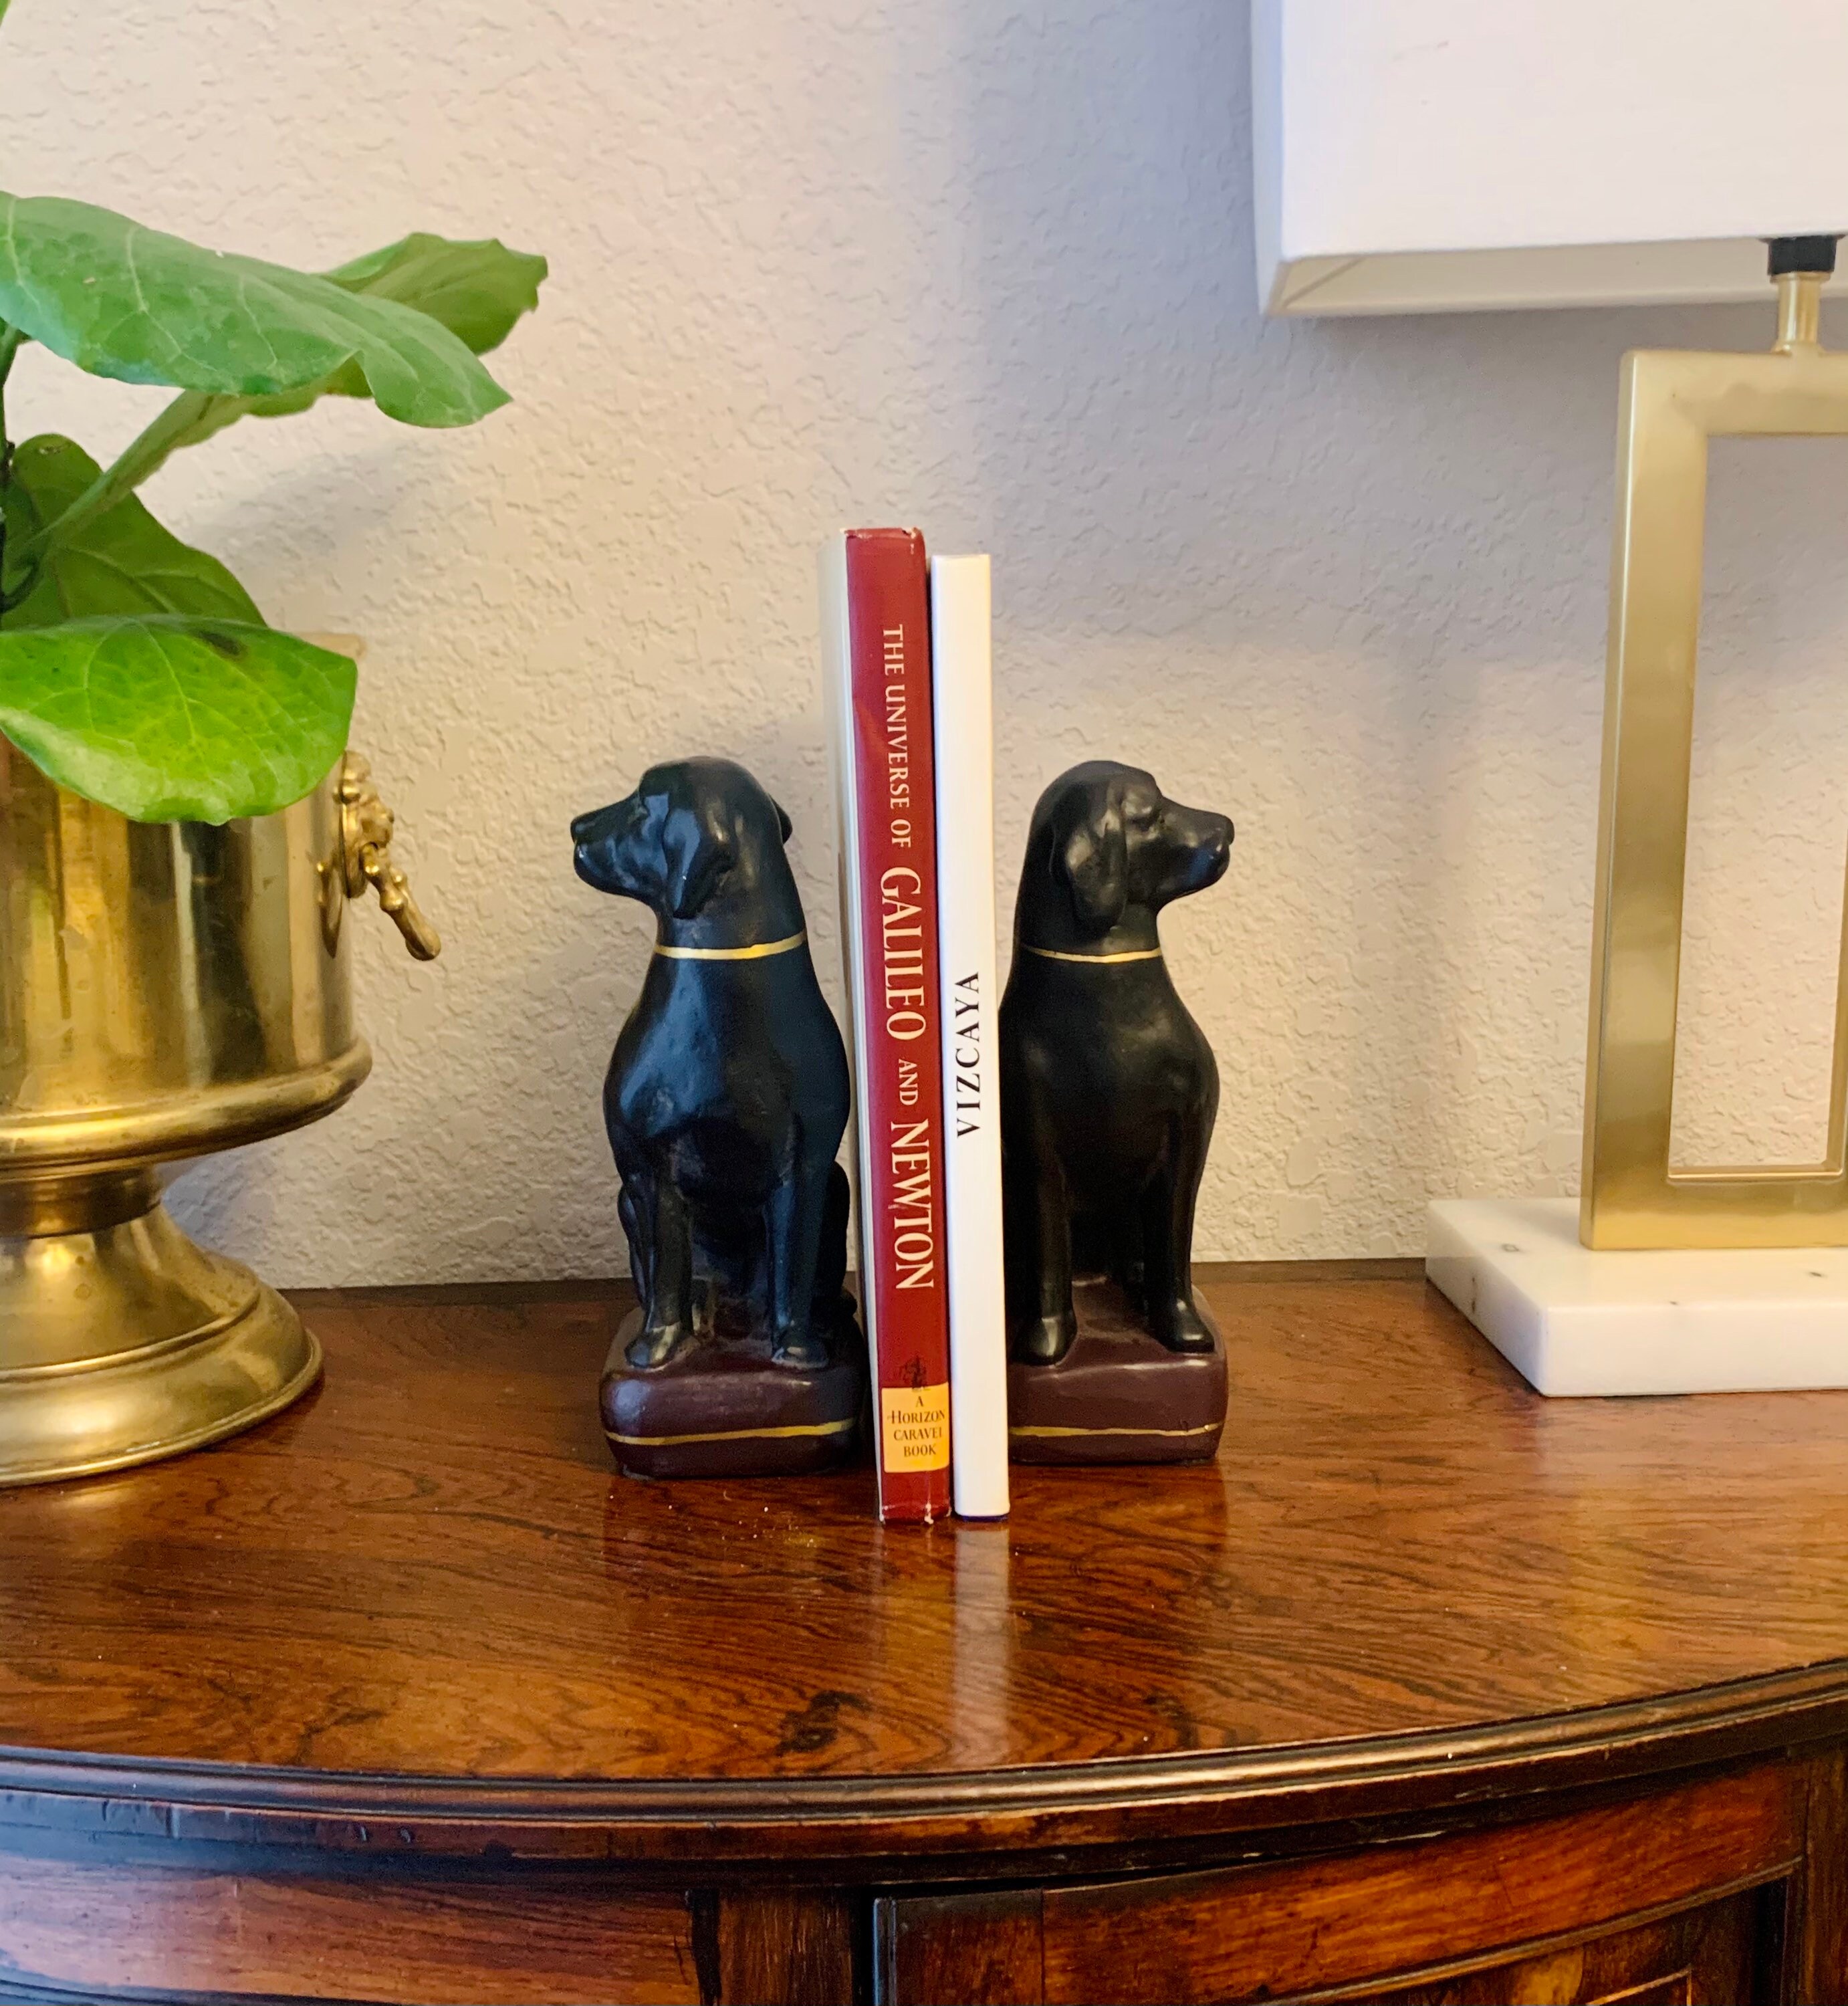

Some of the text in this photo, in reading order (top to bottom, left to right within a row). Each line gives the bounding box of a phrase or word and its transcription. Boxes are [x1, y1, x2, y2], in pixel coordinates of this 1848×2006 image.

[880, 624, 935, 1289] THE UNIVERSE OF GALILEO AND NEWTON
[954, 972, 981, 1139] VIZCAYA
[916, 1396, 924, 1407] A
[904, 1444, 936, 1457] BOOK
